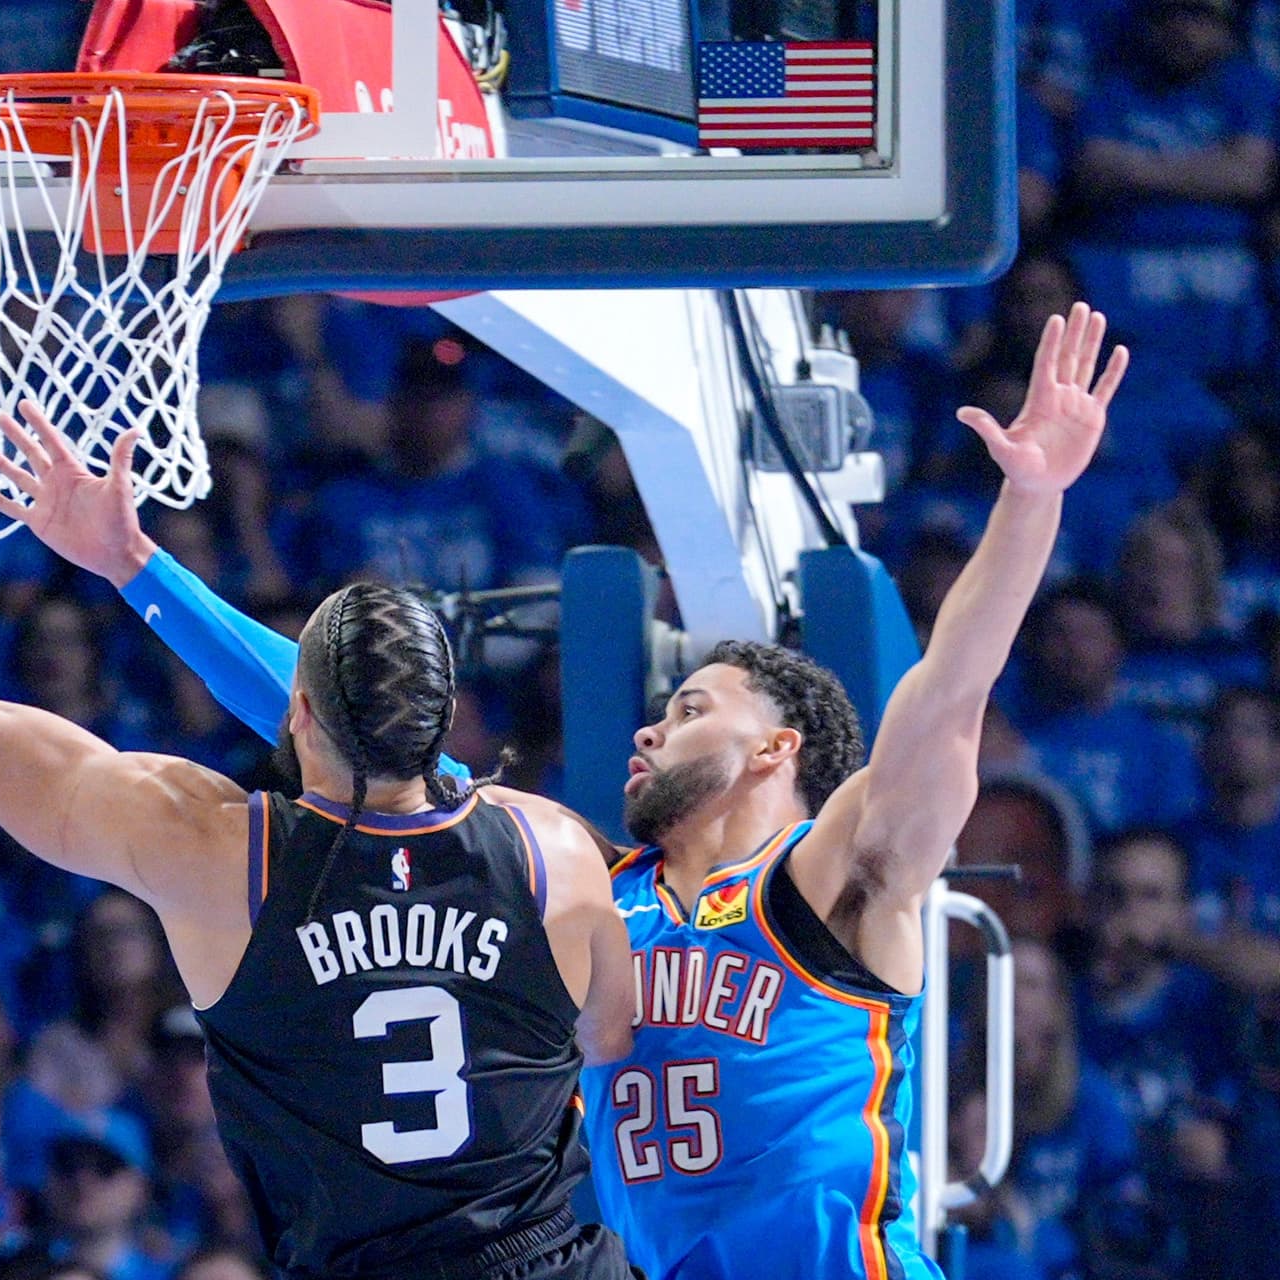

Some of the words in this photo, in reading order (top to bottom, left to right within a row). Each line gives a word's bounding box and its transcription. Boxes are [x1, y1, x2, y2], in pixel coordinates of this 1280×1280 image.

[295, 903, 508, 986] BROOKS
[352, 985, 472, 1165] 3
[612, 1058, 723, 1185] 25
